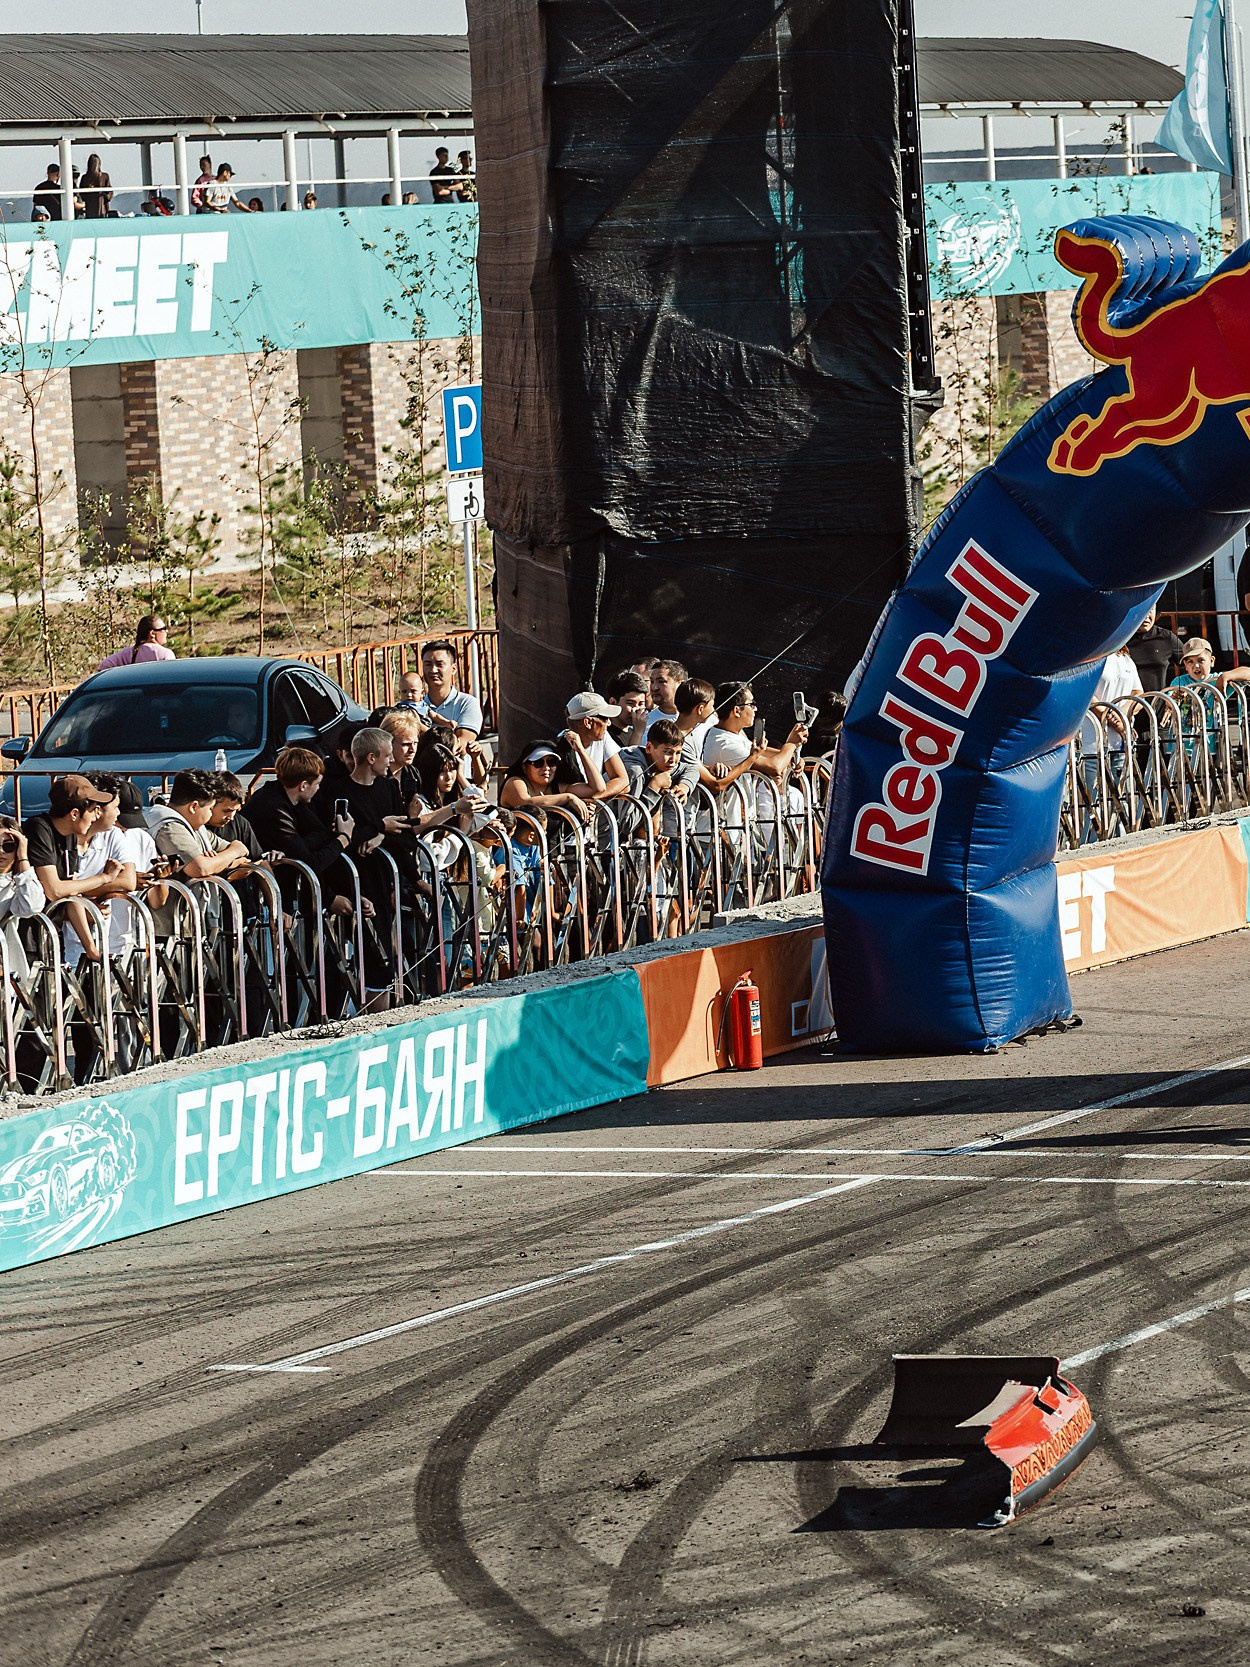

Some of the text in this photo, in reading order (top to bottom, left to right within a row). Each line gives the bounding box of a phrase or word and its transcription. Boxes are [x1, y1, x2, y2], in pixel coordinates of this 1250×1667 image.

[452, 395, 477, 464] P
[850, 538, 1040, 876] Red Bull
[174, 1018, 489, 1206] ЕРТІС-БАЯН
